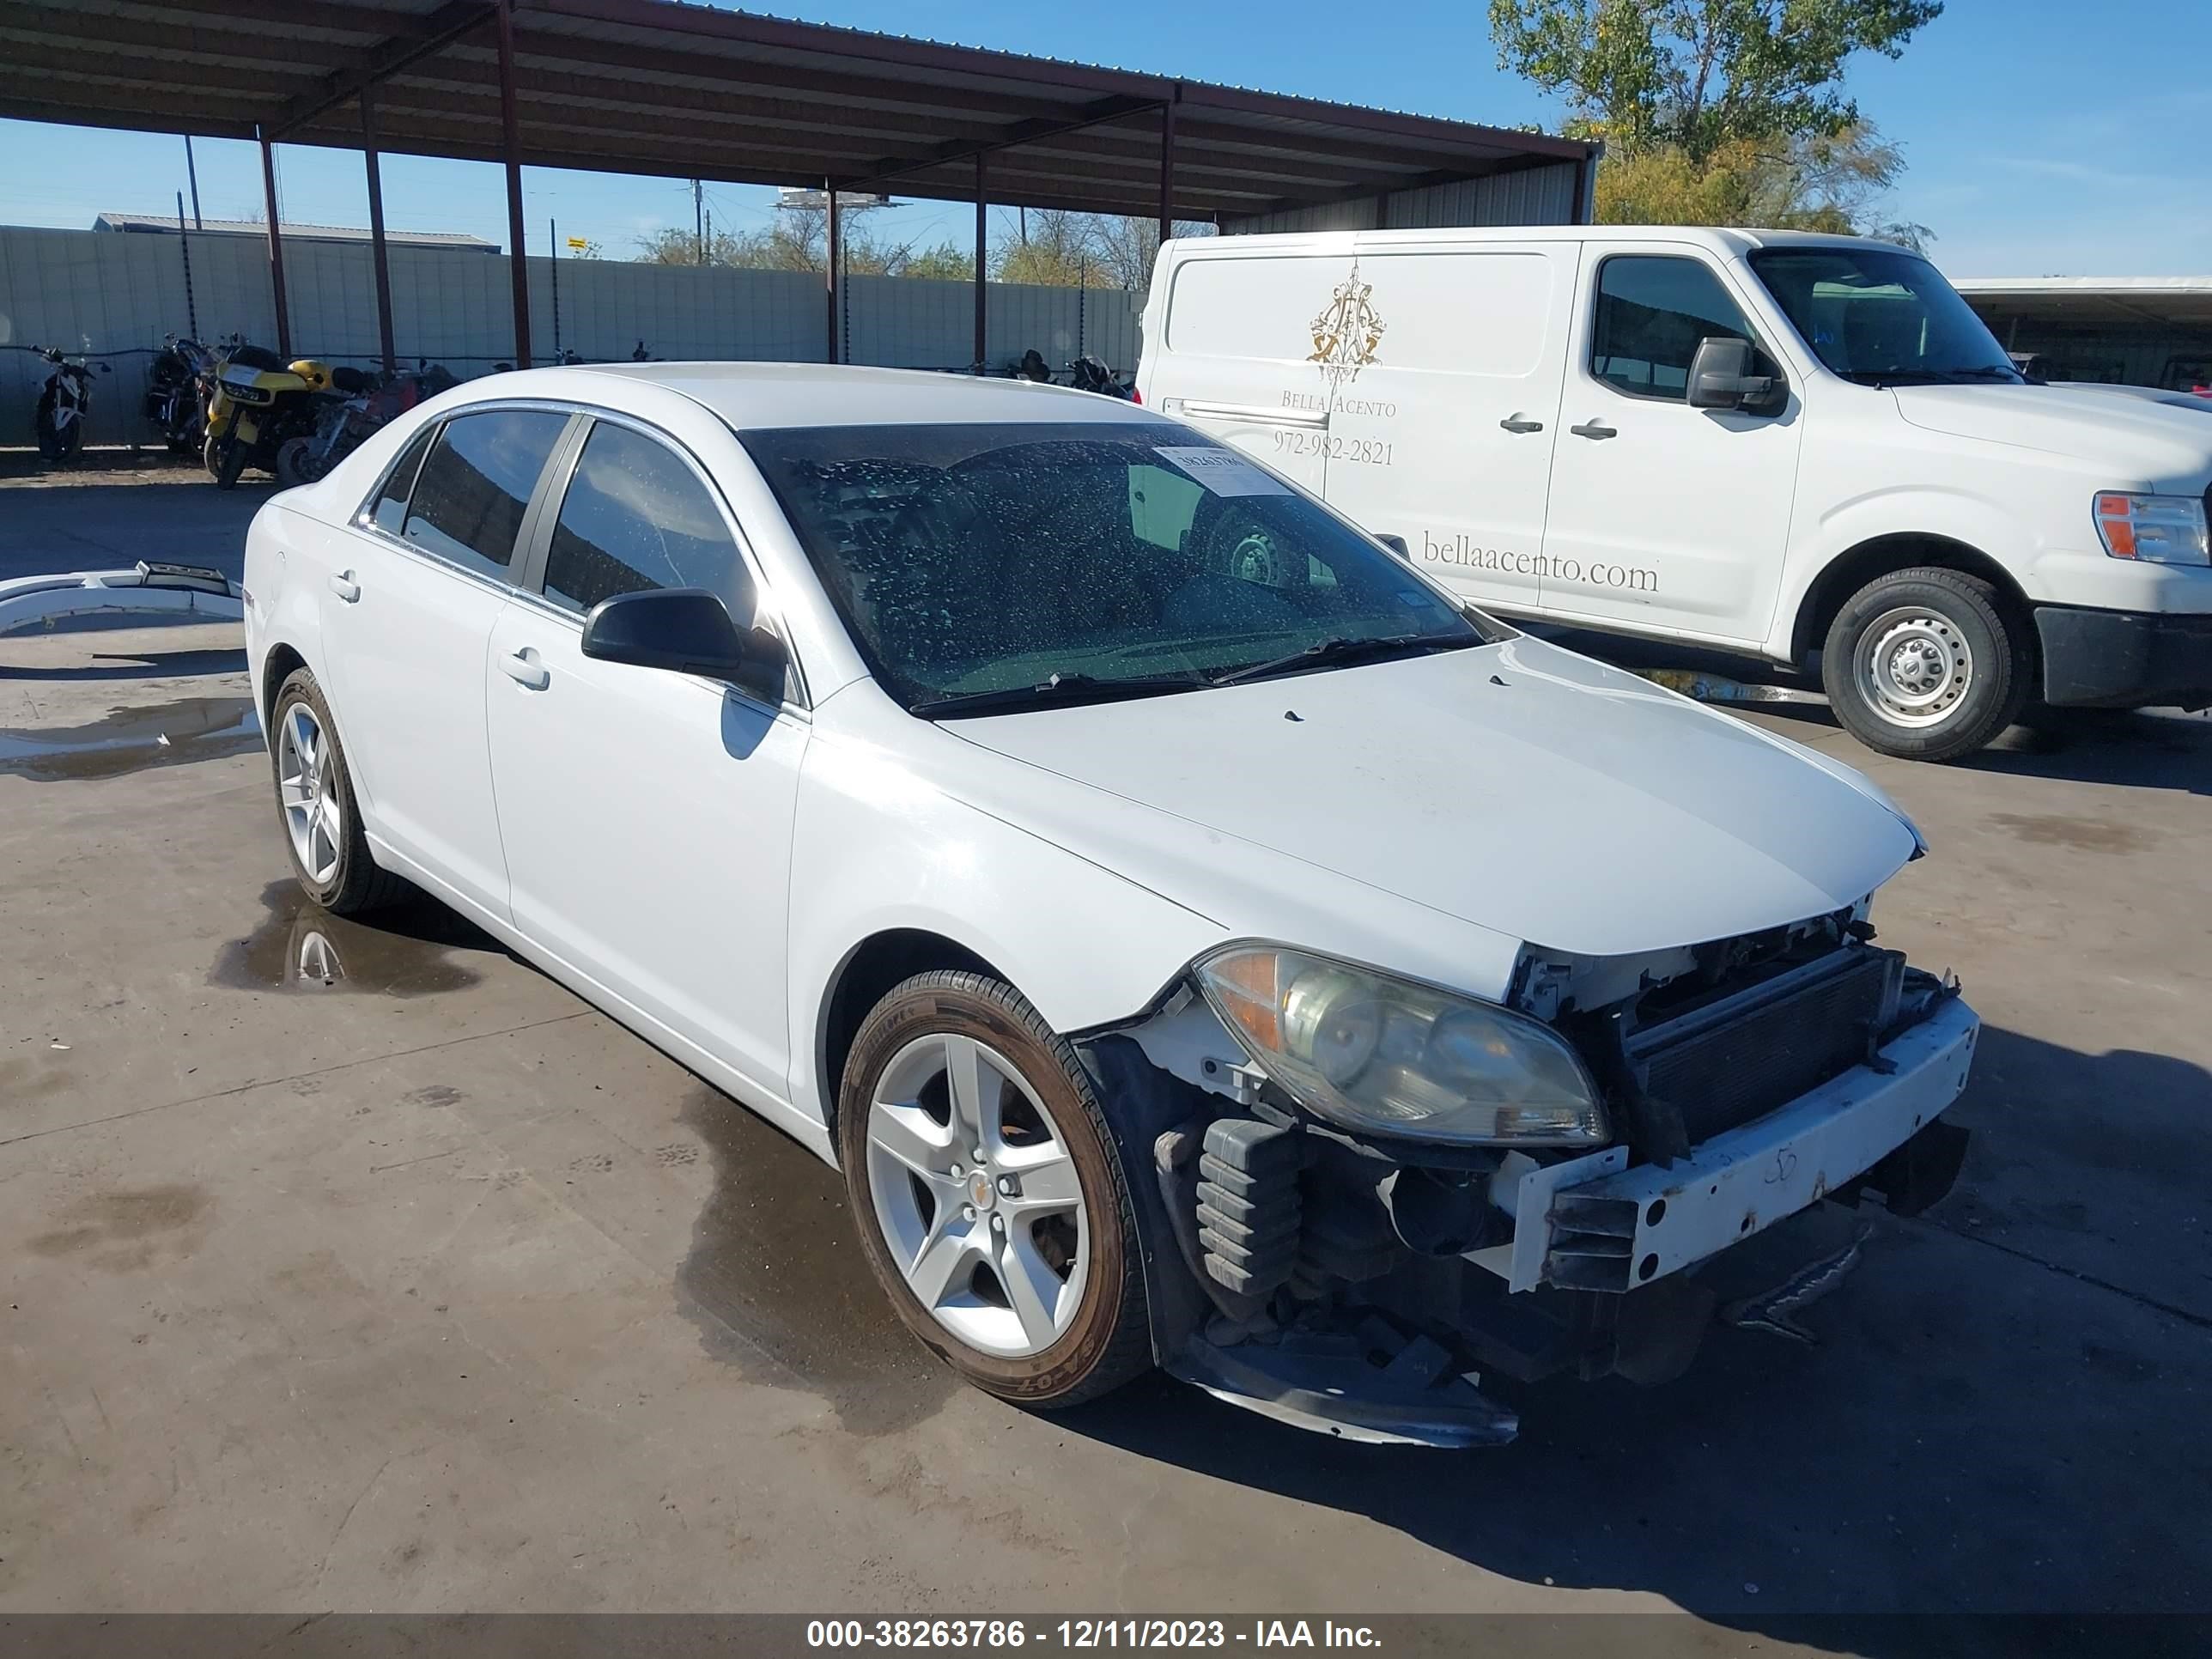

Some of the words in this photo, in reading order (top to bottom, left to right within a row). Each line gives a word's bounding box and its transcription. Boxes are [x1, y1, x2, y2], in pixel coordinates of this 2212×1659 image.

[1281, 390, 1326, 411] BELLA
[1333, 395, 1396, 418] ACENTO
[1273, 430, 1393, 466] 972-982-2821
[1424, 530, 1659, 592] bellaacento.com
